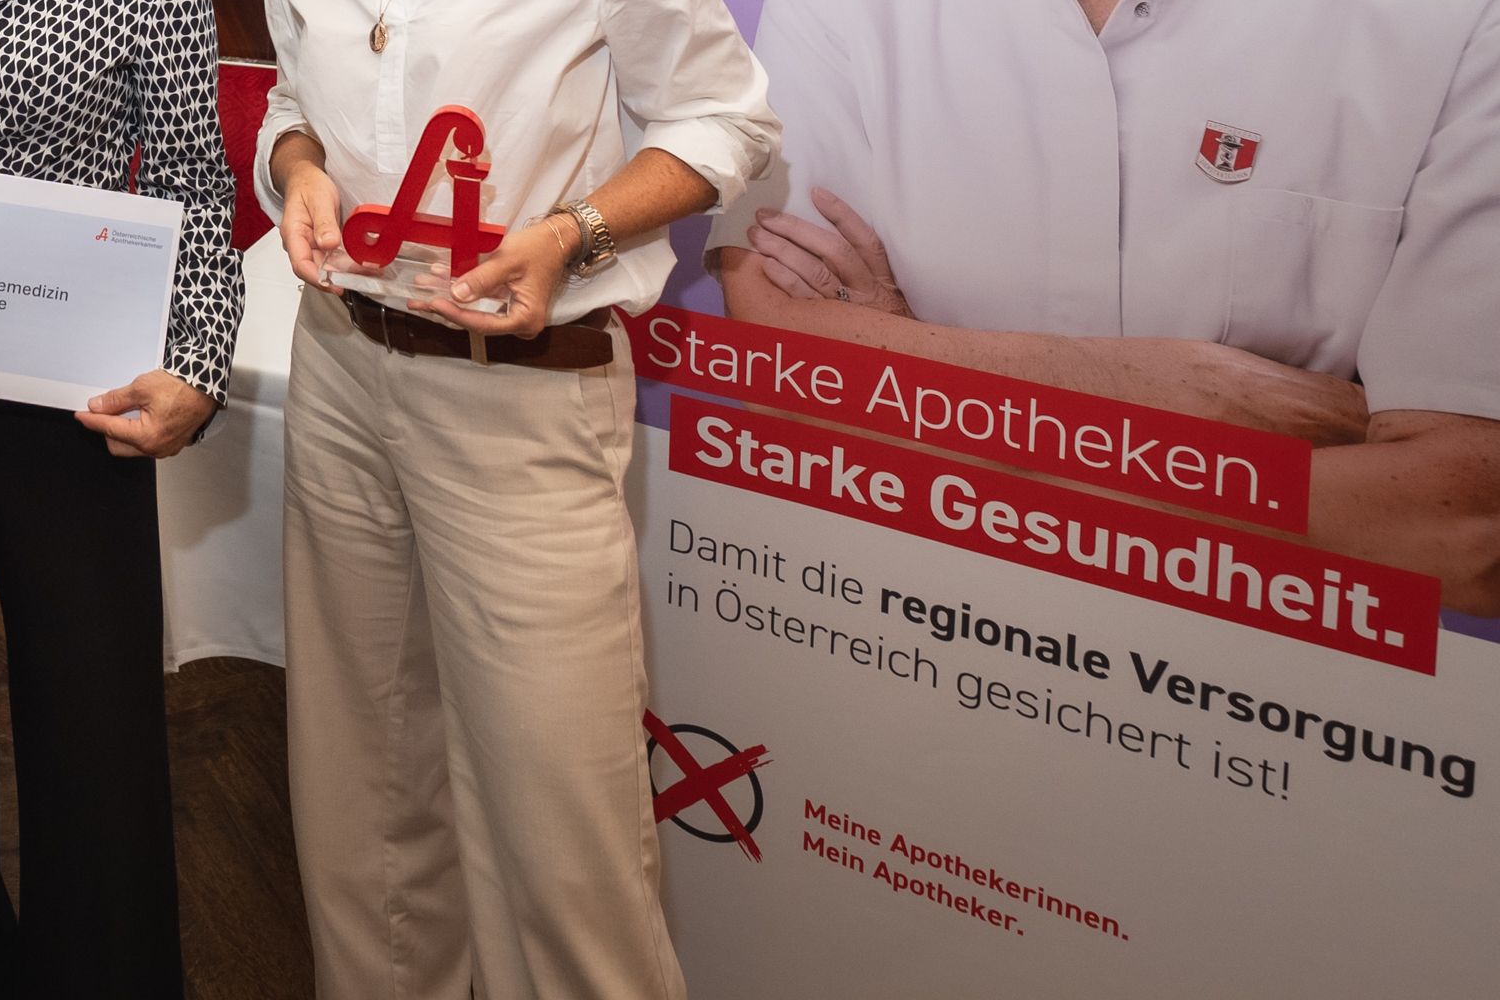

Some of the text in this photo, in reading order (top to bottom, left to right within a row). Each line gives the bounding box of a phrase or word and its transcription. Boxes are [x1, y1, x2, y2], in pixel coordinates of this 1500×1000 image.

[649, 318, 1278, 509] Starke Apotheken.
[695, 416, 1404, 647] Starke Gesundheit.
[668, 573, 1289, 800] in Österreich gesichert ist!
[670, 520, 1475, 798] Damit die regionale Versorgung
[804, 831, 1028, 936] Mein Apotheker.
[805, 799, 1128, 940] Meine Apothekerinnen.
